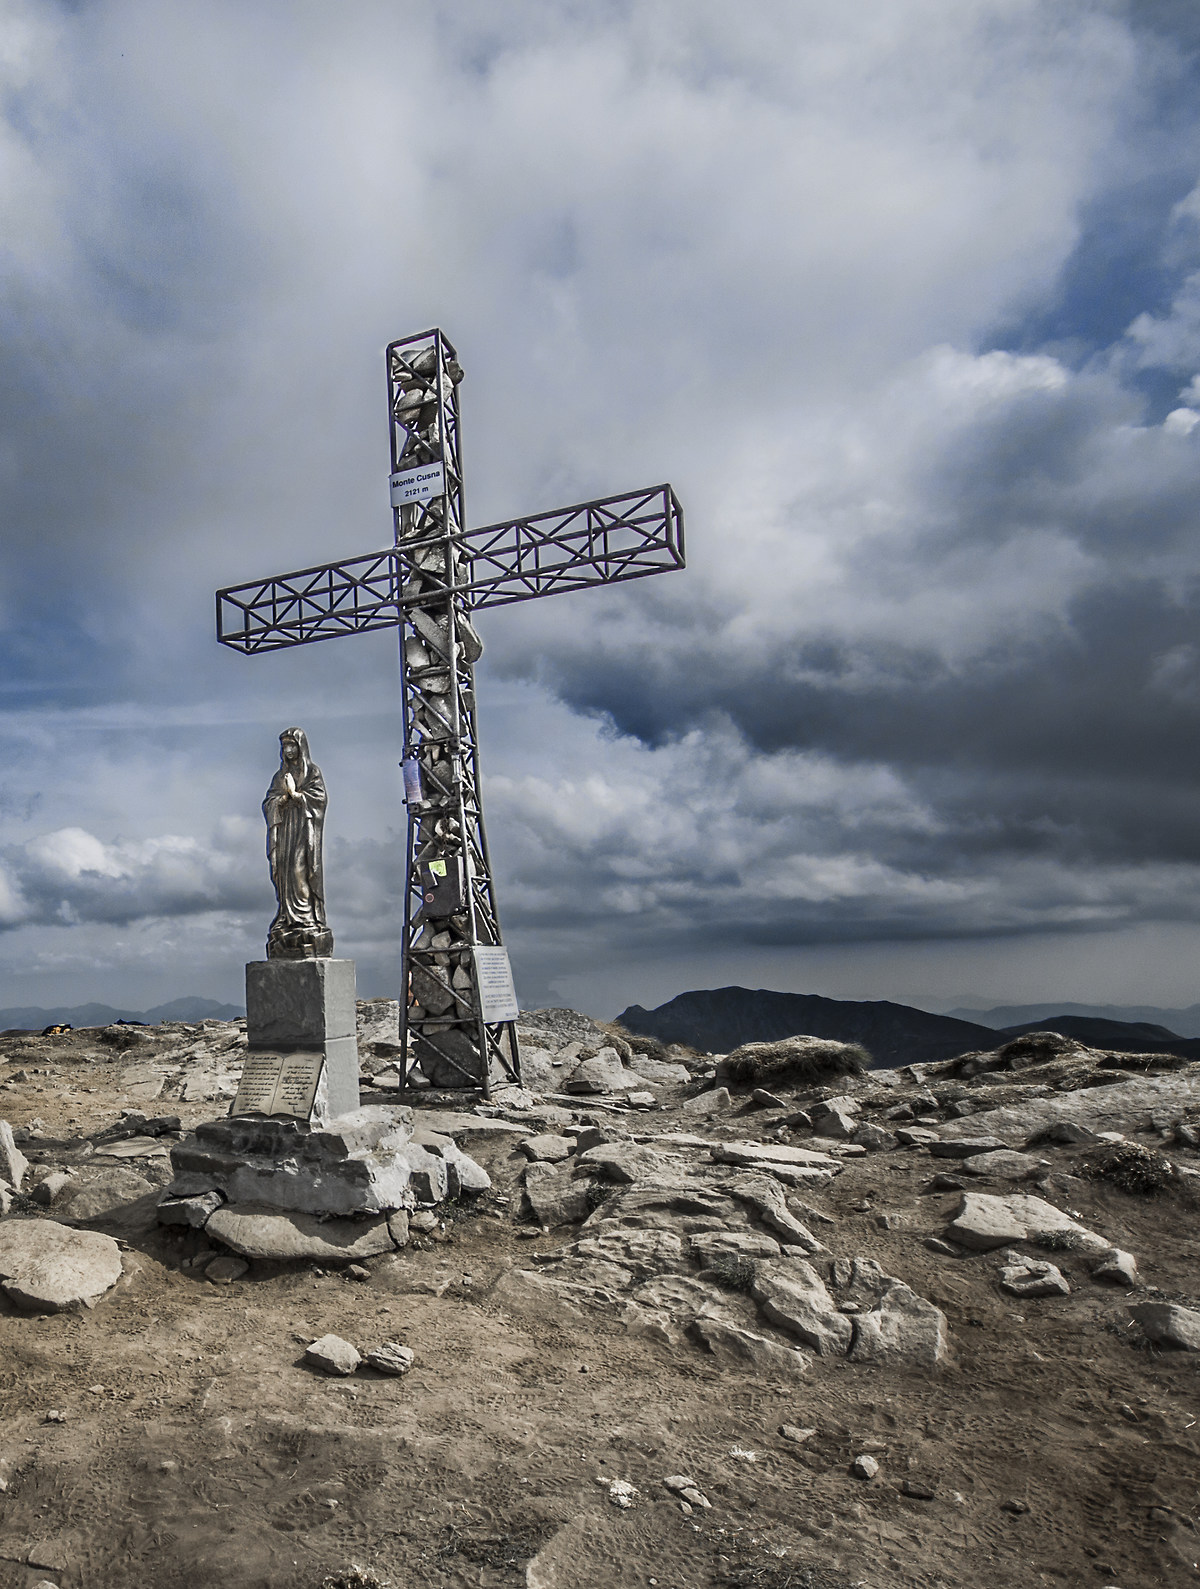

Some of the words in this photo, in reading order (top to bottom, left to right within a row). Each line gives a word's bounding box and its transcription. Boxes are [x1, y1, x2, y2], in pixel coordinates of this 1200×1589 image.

[392, 477, 415, 488] Monte
[416, 471, 440, 482] Cusna
[404, 488, 420, 497] 2121
